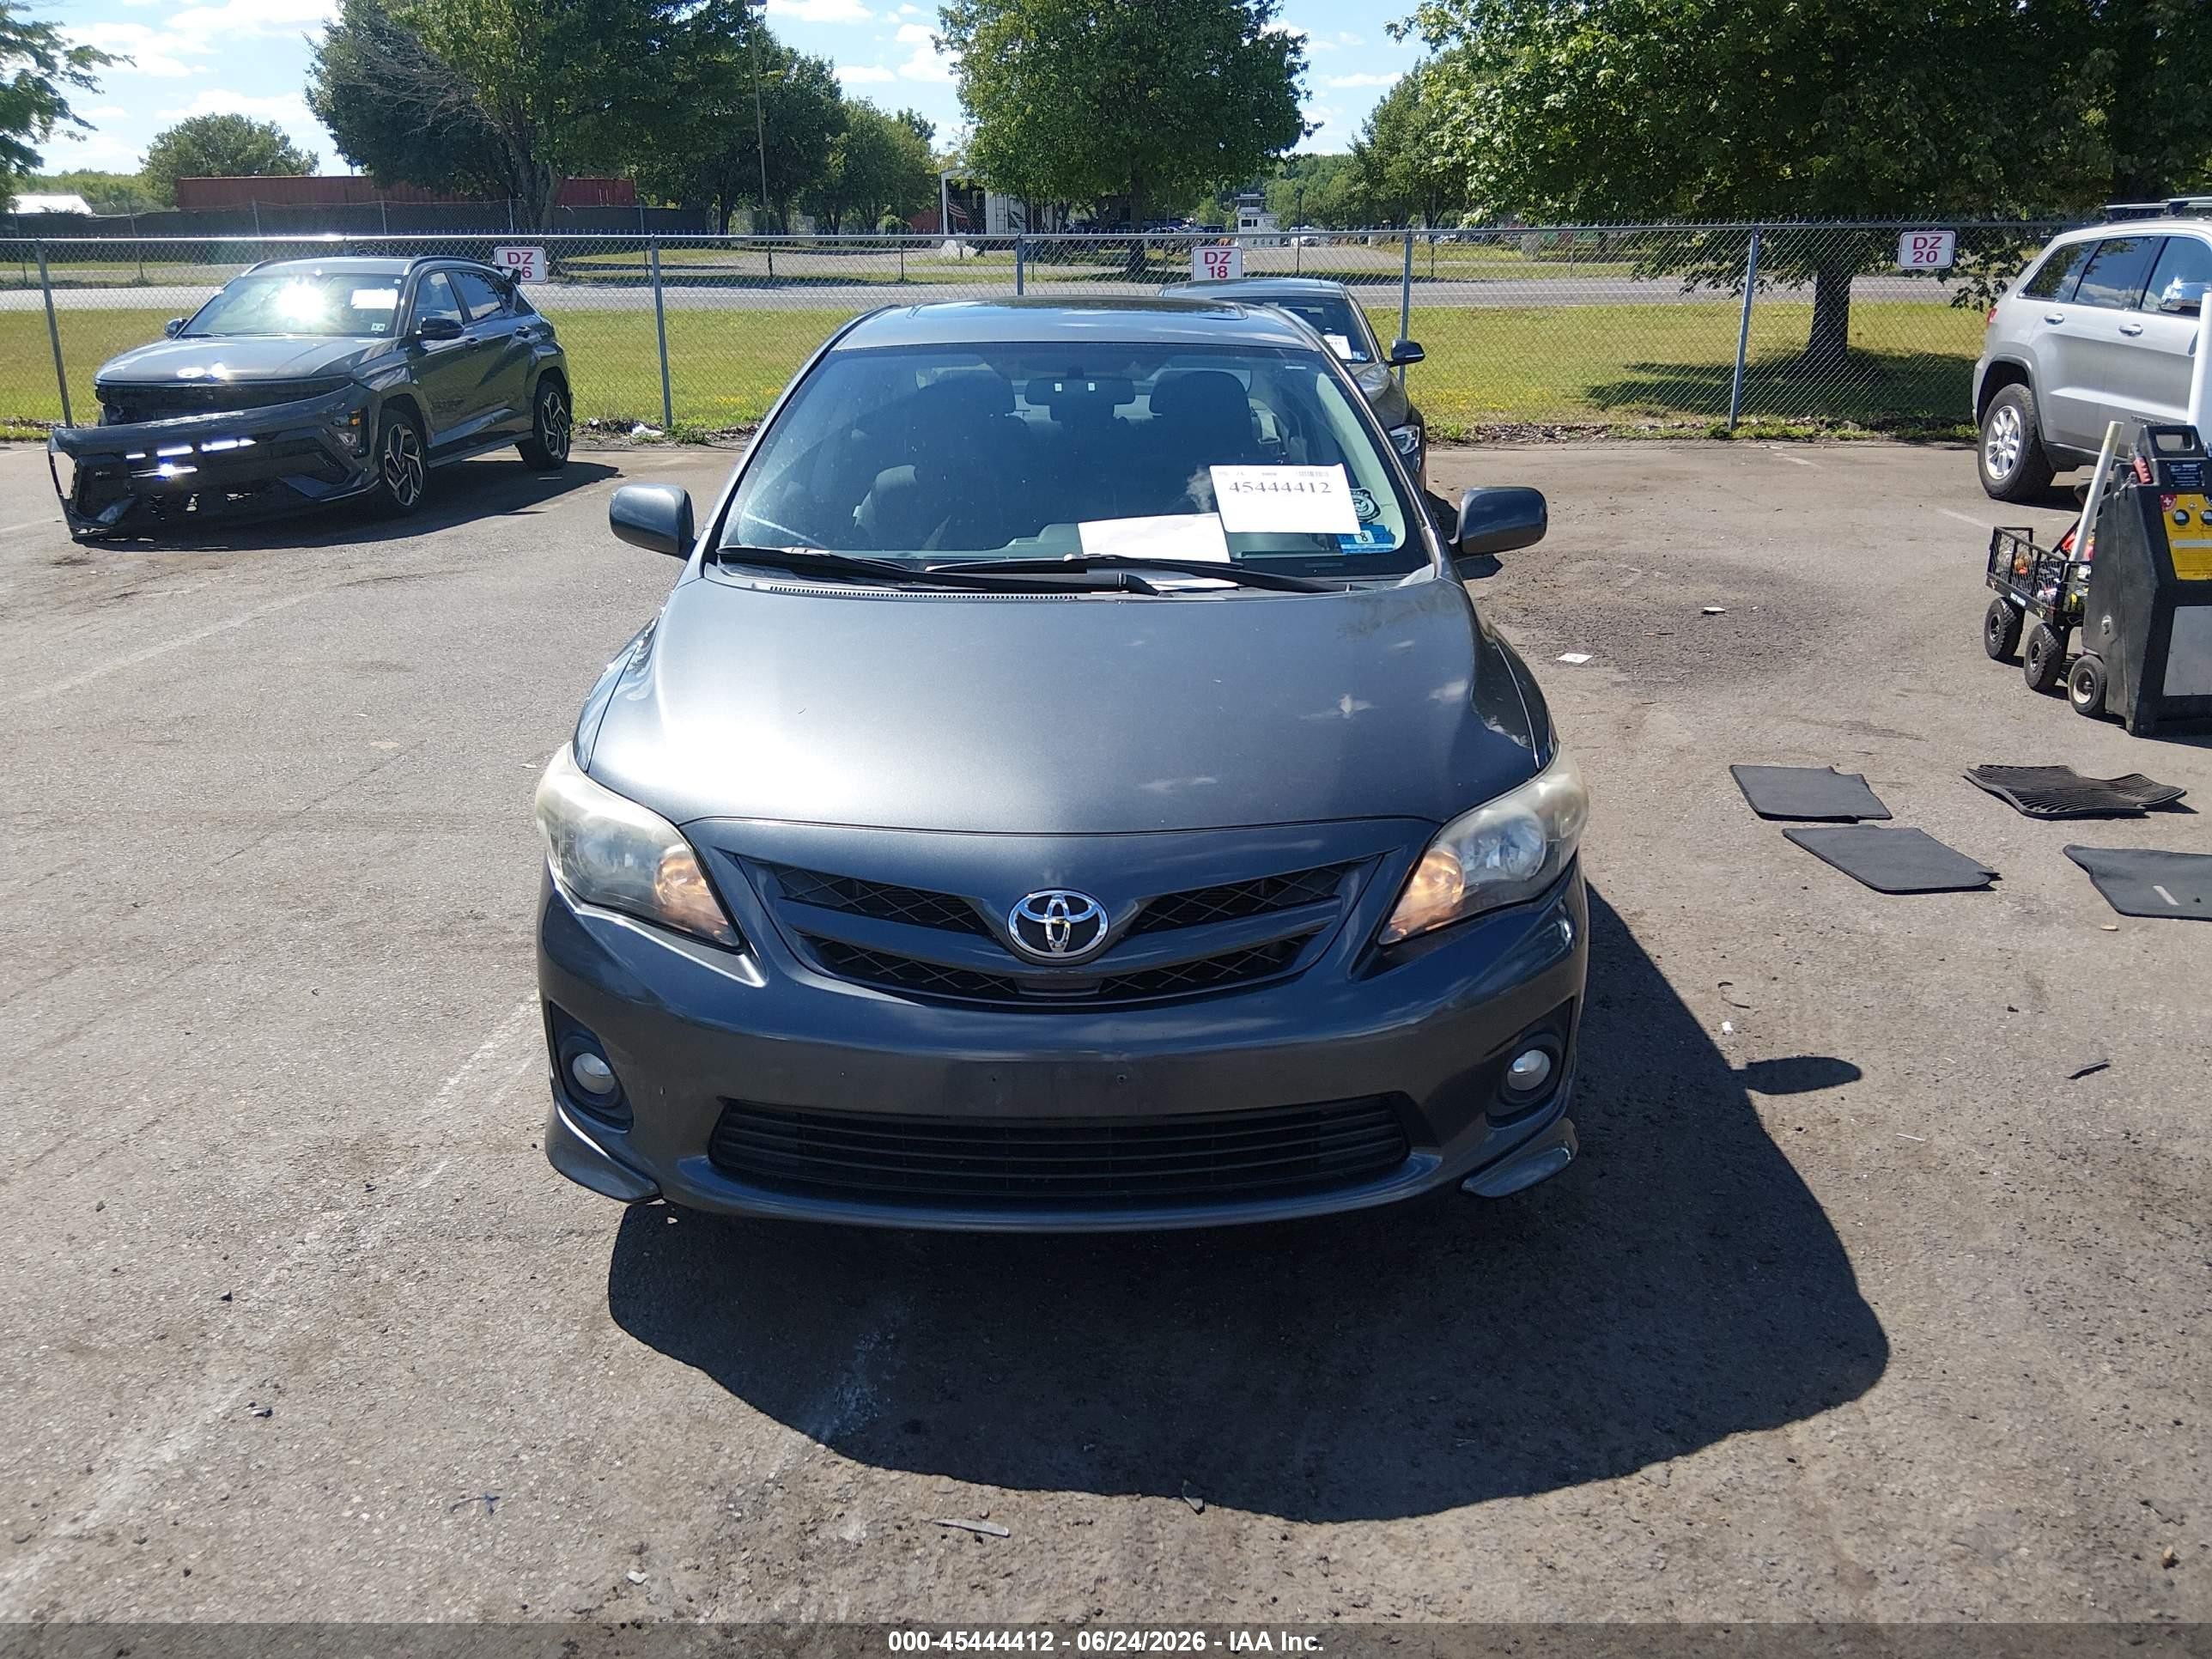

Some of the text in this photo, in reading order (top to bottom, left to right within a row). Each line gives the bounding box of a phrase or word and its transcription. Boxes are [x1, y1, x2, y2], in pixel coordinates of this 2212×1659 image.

[1912, 236, 1943, 250] DZ
[507, 252, 535, 264] DZ
[1204, 252, 1232, 264] DZ
[1912, 251, 1938, 264] 20
[520, 266, 532, 279] 6
[1208, 265, 1229, 279] 18
[1229, 481, 1332, 494] 45444412
[1359, 532, 1369, 543] 8
